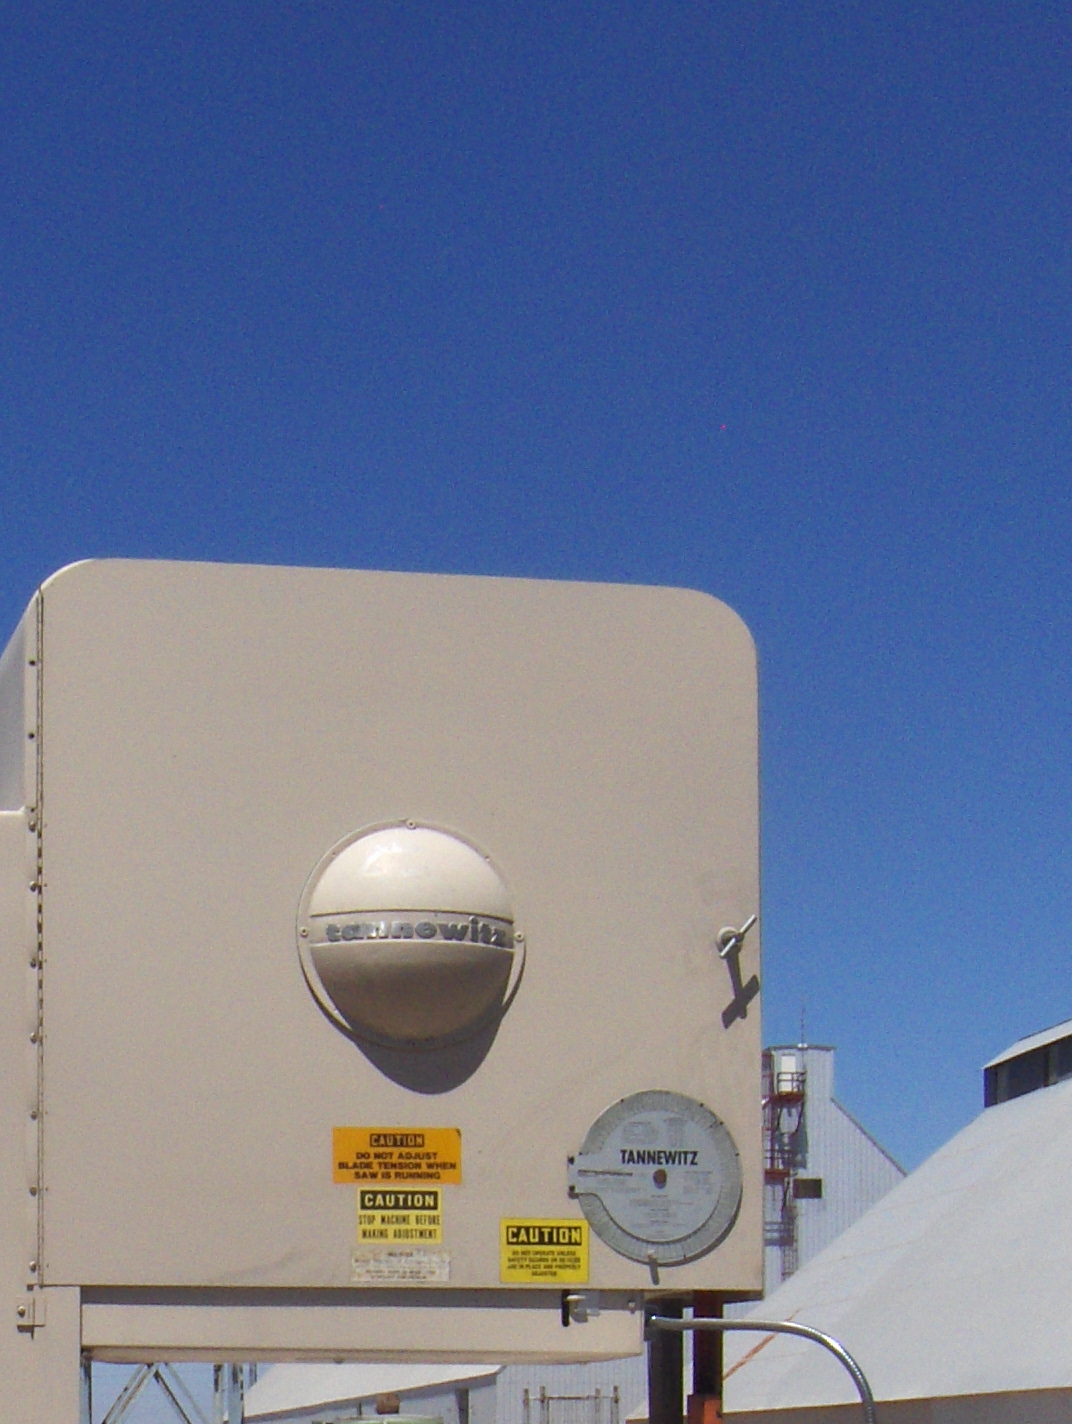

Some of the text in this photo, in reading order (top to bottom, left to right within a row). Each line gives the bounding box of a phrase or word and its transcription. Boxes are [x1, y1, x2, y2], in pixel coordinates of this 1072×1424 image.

[326, 916, 505, 947] tannewitz
[371, 1135, 424, 1147] CAUTION
[356, 1151, 438, 1160] DO NOT ADJUST
[620, 1149, 699, 1166] TANNEWITZ
[338, 1161, 457, 1170] BLADE TENSION WHEN
[354, 1171, 441, 1180] SAW IS RUNNING
[364, 1194, 435, 1207] CAUTION
[359, 1215, 441, 1225] STOP MACHINE BEFORE
[362, 1229, 437, 1239] MAKING ADJUSTMENT
[508, 1227, 581, 1243] CAUTION
